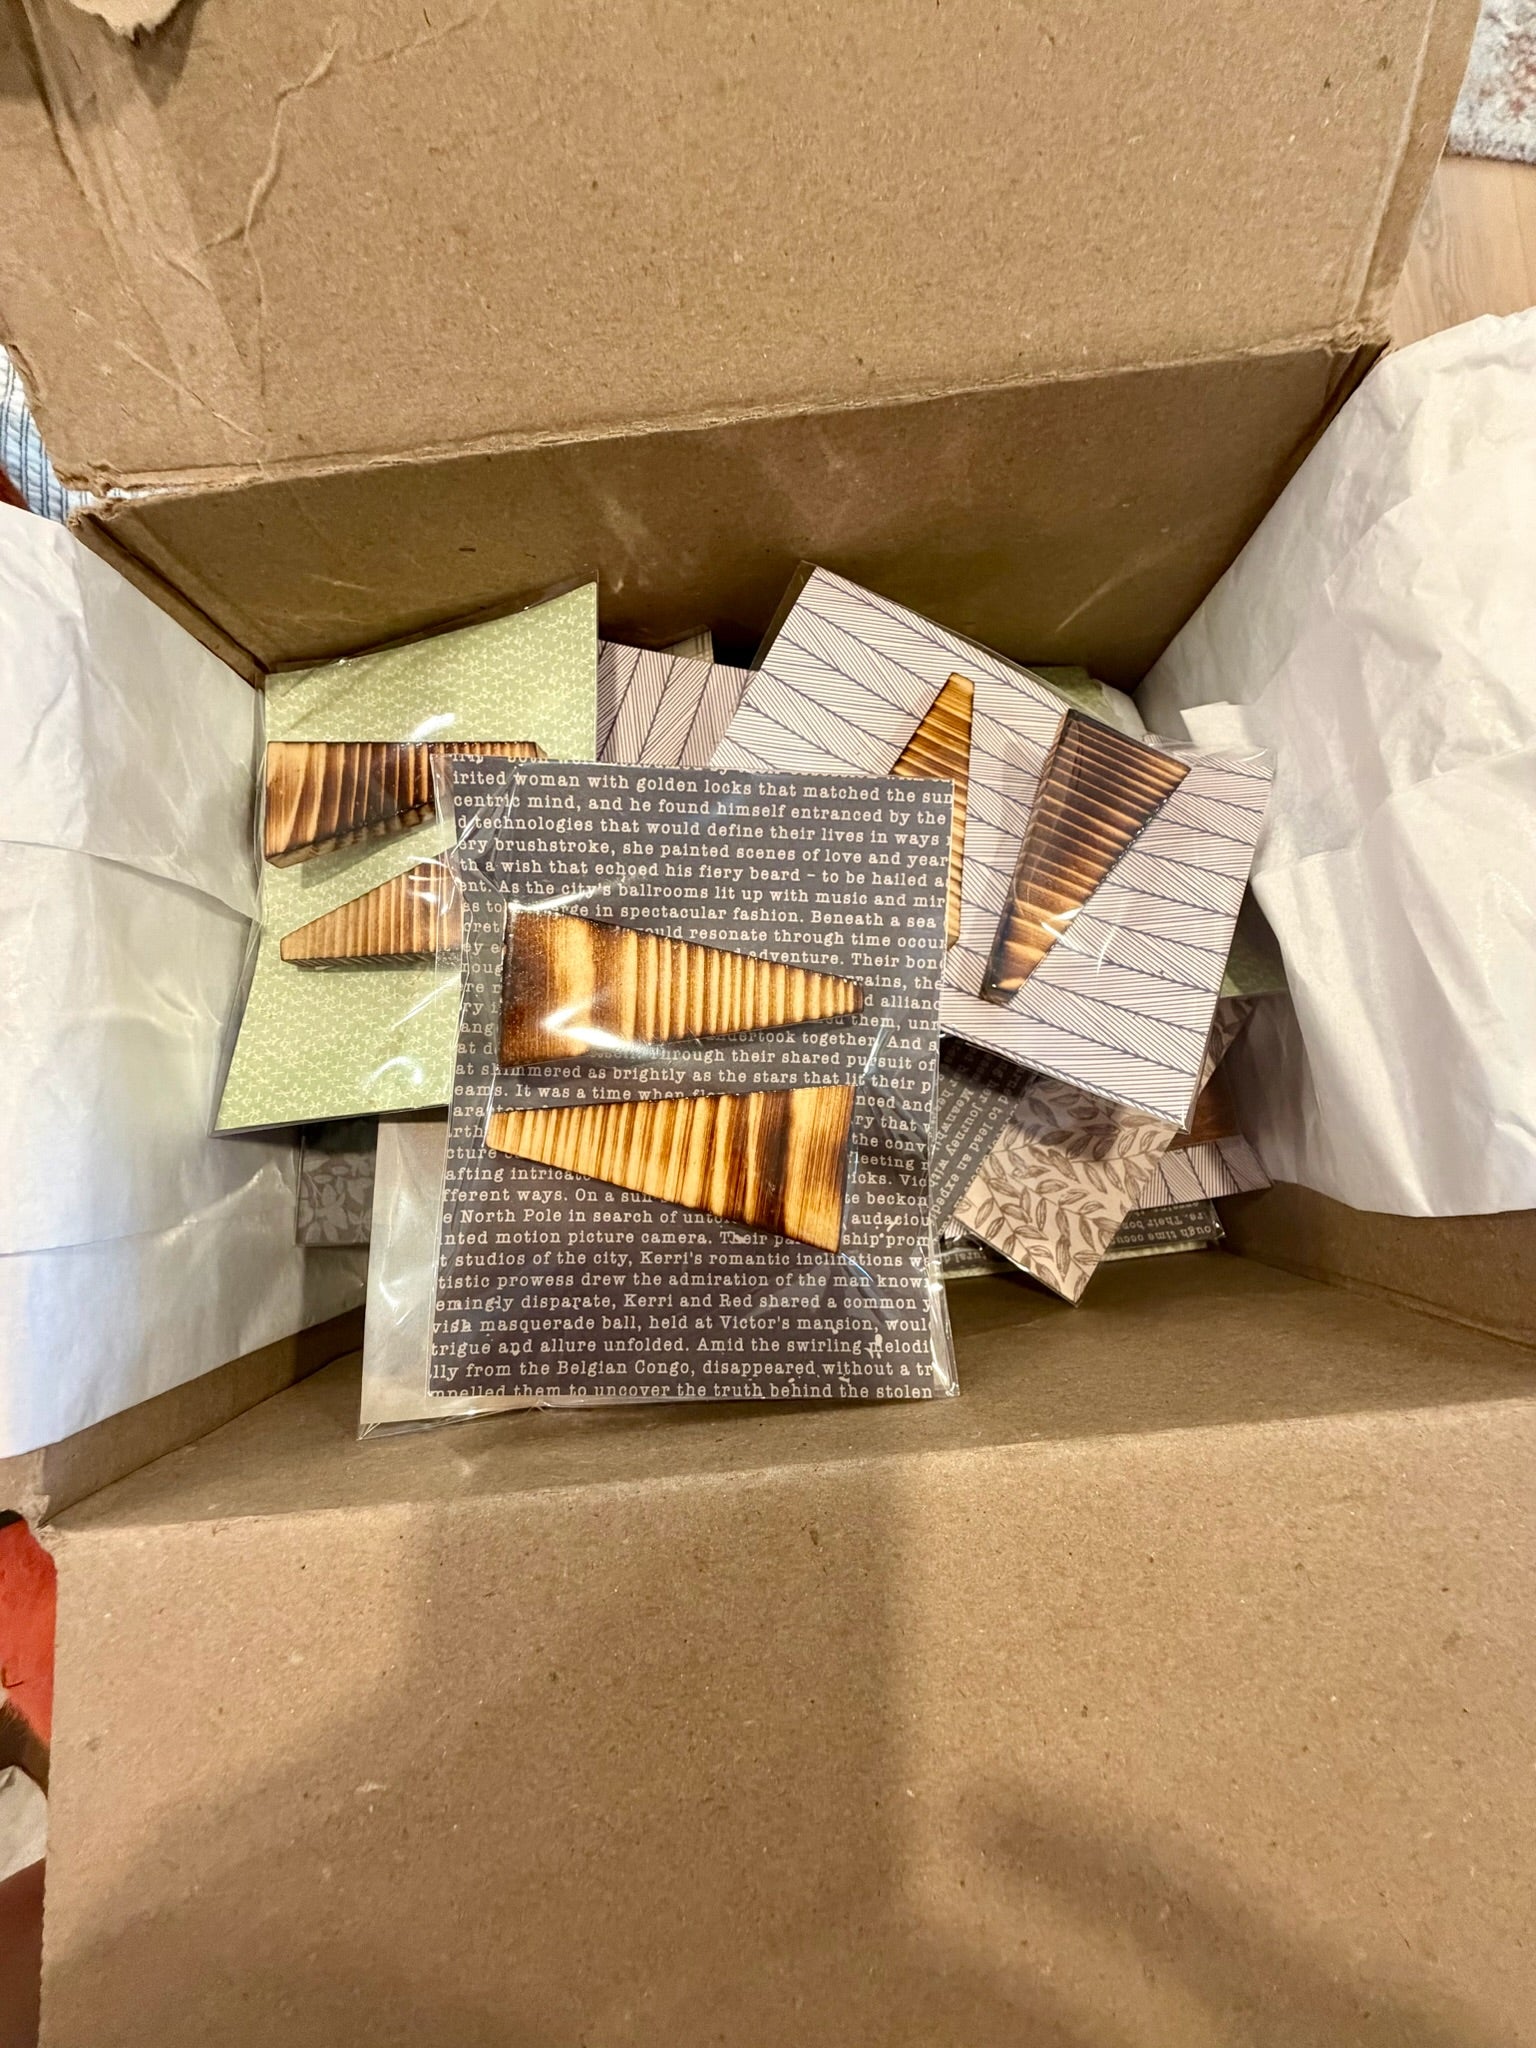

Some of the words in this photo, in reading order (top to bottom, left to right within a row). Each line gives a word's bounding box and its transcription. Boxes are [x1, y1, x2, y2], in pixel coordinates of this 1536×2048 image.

[514, 774, 580, 787] woman
[588, 776, 629, 790] with
[637, 777, 698, 793] golden
[704, 780, 751, 795] locks
[759, 783, 797, 797] that
[803, 786, 880, 801] matched
[887, 789, 915, 803] the
[454, 794, 520, 808] centric
[528, 796, 581, 812] mind,
[589, 799, 623, 811] and
[630, 800, 651, 812] he
[659, 800, 709, 815] found
[717, 803, 786, 818] himself
[791, 808, 883, 823] entranced
[890, 810, 910, 825] by
[917, 812, 946, 825] the
[475, 817, 593, 833] technologies
[601, 820, 639, 833] that
[647, 822, 700, 836] would
[708, 824, 764, 838] define
[771, 827, 816, 841] their
[821, 828, 864, 842] lives
[870, 831, 887, 843] in
[895, 833, 939, 847] ways
[496, 839, 615, 856] brushstroke,
[623, 841, 654, 855] she
[661, 844, 730, 858] painted
[737, 848, 796, 861] scenes
[803, 849, 820, 862] of
[825, 850, 862, 863] love
[869, 852, 901, 865] and
[485, 862, 495, 872] a
[501, 859, 543, 873] wish
[550, 861, 588, 874] that
[595, 862, 659, 876] echoed
[666, 863, 692, 877] his
[699, 863, 743, 882] fiery
[750, 867, 800, 881] beard
[822, 870, 839, 883] to
[846, 871, 865, 884] be
[872, 873, 928, 887] hailed
[500, 880, 520, 894] As
[526, 881, 555, 894] the
[562, 882, 611, 899] city's
[619, 883, 708, 899] ballrooms
[715, 886, 735, 899] lit
[742, 888, 763, 903] up
[769, 889, 809, 903] with
[815, 891, 867, 905] music
[874, 893, 906, 906] and
[596, 904, 613, 917] in
[621, 904, 727, 921] spectacular
[733, 908, 804, 923] fashion.
[811, 911, 885, 927] Beneath
[891, 916, 901, 927] a
[907, 916, 937, 928] sea
[689, 925, 768, 941] resonate
[774, 929, 844, 946] through
[851, 933, 891, 947] time
[852, 954, 900, 967] Their
[852, 1014, 901, 1030] them,
[886, 1037, 922, 1050] And
[732, 1051, 776, 1063] their
[782, 1053, 840, 1065] shared
[847, 1055, 912, 1069] pursuit
[588, 1069, 606, 1079] as
[614, 1068, 685, 1083] brightly
[692, 1072, 712, 1083] as
[719, 1070, 747, 1083] the
[753, 1072, 798, 1084] stars
[803, 1072, 840, 1085] that
[845, 1072, 865, 1086] lit
[871, 1074, 915, 1091] their
[515, 1084, 531, 1097] It
[538, 1088, 571, 1098] was
[577, 1089, 586, 1099] a
[592, 1087, 632, 1100] time
[989, 1105, 1003, 1120] to
[880, 1116, 918, 1132] that
[948, 1102, 984, 1160] journey
[969, 1121, 994, 1153] lead
[956, 1152, 973, 1172] an
[517, 1191, 568, 1202] ways.
[576, 1189, 598, 1201] On
[605, 1191, 614, 1202] a
[460, 1209, 516, 1224] North
[523, 1210, 562, 1223] Pole
[569, 1211, 586, 1223] in
[593, 1210, 653, 1224] search
[660, 1210, 677, 1224] of
[495, 1231, 561, 1244] motion
[568, 1230, 634, 1246] picture
[641, 1232, 713, 1245] camera.
[720, 1234, 768, 1245] Their
[455, 1251, 526, 1267] studios
[533, 1252, 551, 1265] of
[557, 1252, 586, 1265] the
[593, 1252, 633, 1267] city,
[640, 1253, 702, 1265] Kerri's
[709, 1253, 790, 1266] romantic
[796, 1253, 903, 1268] inclinations
[497, 1275, 574, 1290] prowess
[581, 1273, 627, 1286] drew
[633, 1273, 662, 1286] the
[669, 1274, 769, 1288] admiration
[776, 1275, 793, 1287] of
[799, 1274, 827, 1287] the
[834, 1277, 870, 1288] man
[521, 1294, 616, 1311] disparate,
[624, 1293, 673, 1308] Kerri
[680, 1295, 712, 1308] and
[719, 1295, 753, 1308] Red
[759, 1295, 820, 1309] shared
[827, 1298, 837, 1309] a
[844, 1299, 917, 1309] common
[480, 1317, 594, 1333] masquerade
[602, 1316, 642, 1332] ball,
[649, 1317, 688, 1329] held
[695, 1318, 713, 1330] at
[719, 1317, 790, 1330] Victor's
[797, 1319, 879, 1333] mansion,
[498, 1340, 533, 1354] and
[541, 1340, 597, 1353] allure
[604, 1339, 689, 1352] unfolded.
[696, 1339, 745, 1352] Amid
[751, 1338, 780, 1352] the
[787, 1338, 862, 1356] swirling
[466, 1362, 511, 1377] from
[520, 1362, 550, 1376] the
[557, 1360, 627, 1377] Belgian
[635, 1359, 696, 1377] Congo,
[703, 1361, 816, 1377] disappeared
[822, 1361, 893, 1377] without
[900, 1365, 910, 1376] a
[514, 1385, 561, 1397] them
[569, 1385, 587, 1397] to
[595, 1385, 670, 1397] uncover
[677, 1384, 707, 1397] the
[714, 1384, 763, 1397] truth
[771, 1384, 832, 1398] behind
[840, 1384, 869, 1398] the
[877, 1384, 933, 1399] stolen
